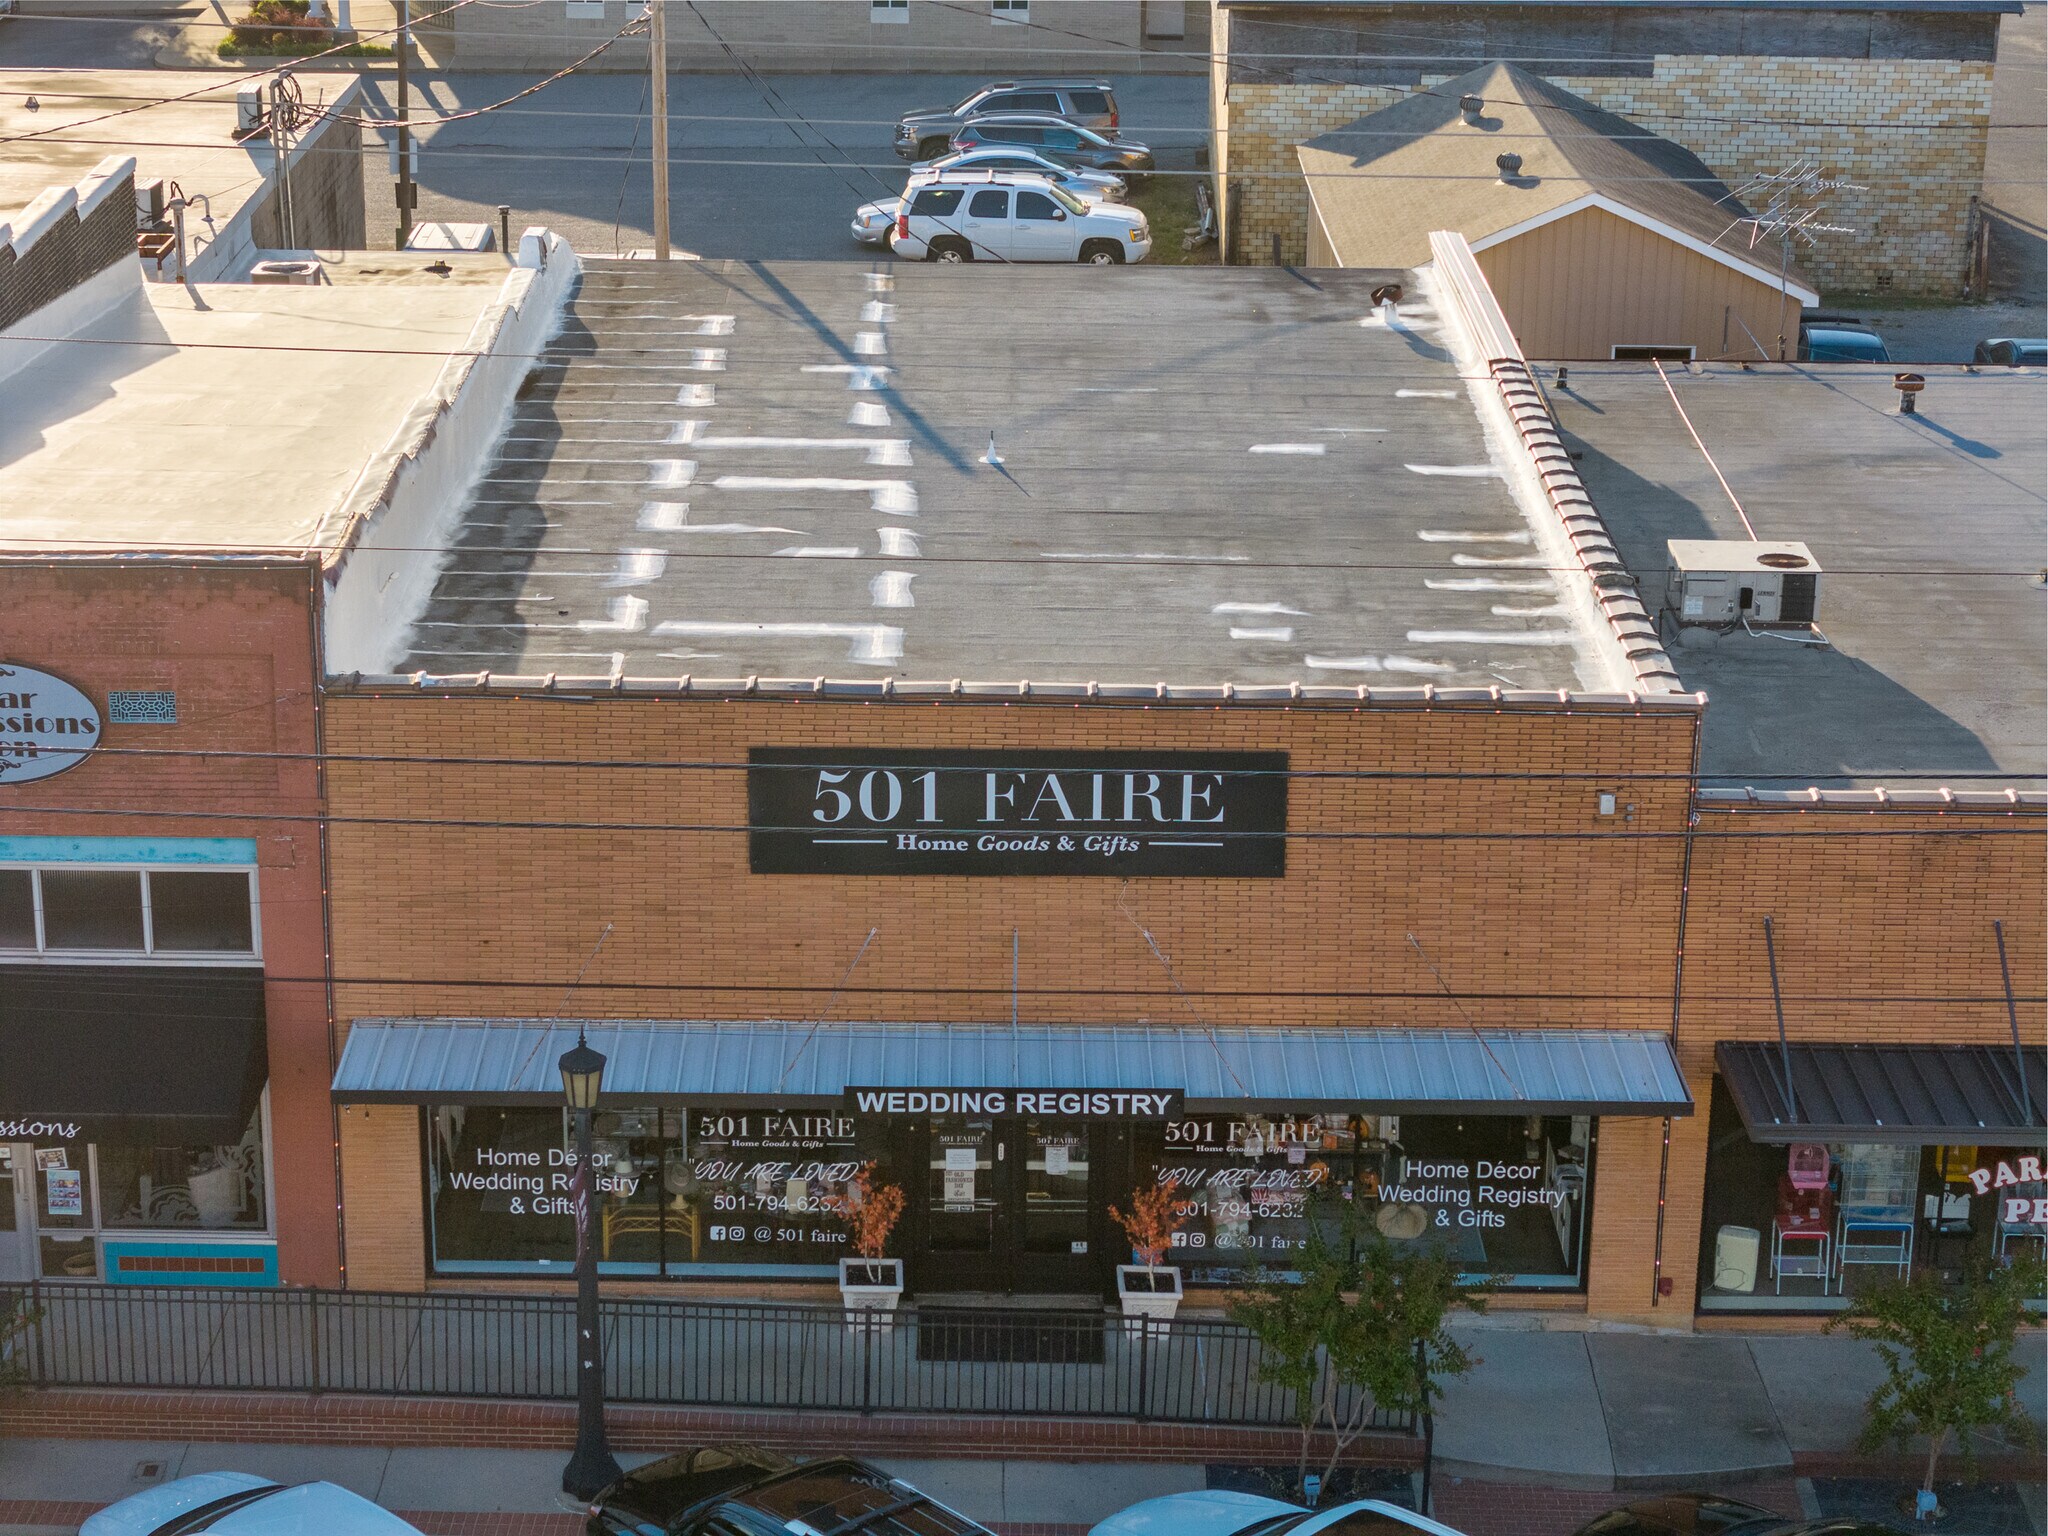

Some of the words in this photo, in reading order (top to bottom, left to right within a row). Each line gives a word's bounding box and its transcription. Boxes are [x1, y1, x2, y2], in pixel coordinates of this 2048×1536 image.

[812, 770, 944, 823] 501
[977, 772, 1225, 823] FAIRE
[896, 834, 969, 853] Home
[977, 834, 1050, 853] Goods
[1056, 835, 1075, 852] &
[1083, 836, 1140, 856] Gifts
[857, 1091, 1006, 1114] WEDDING
[1016, 1093, 1172, 1115] REGISTRY
[700, 1116, 749, 1137] 501
[762, 1117, 855, 1138] FAIRE
[1165, 1121, 1215, 1142] 501
[1227, 1122, 1320, 1143] FAIRE
[762, 1140, 790, 1148] Goods
[802, 1140, 824, 1149] Gifts
[1226, 1145, 1253, 1153] Goods
[1266, 1146, 1288, 1154] Gifts
[477, 1148, 541, 1166] Home
[549, 1148, 613, 1167] Déor
[744, 1162, 791, 1181] ARE
[1207, 1168, 1254, 1188] ARE
[1406, 1161, 1469, 1178] Home
[1476, 1161, 1541, 1179] Décor
[1968, 1156, 2047, 1195] PAR
[450, 1172, 544, 1195] Wedding
[552, 1173, 639, 1196] Ristry
[510, 1198, 526, 1214] &
[1378, 1185, 1471, 1206] Wedding
[1479, 1185, 1566, 1208] Registry
[1435, 1209, 1450, 1227] &
[1458, 1209, 1506, 1227] Gifts
[754, 1226, 771, 1242] @
[777, 1229, 804, 1242] 501
[811, 1229, 847, 1243] faire
[1214, 1232, 1232, 1249] @
